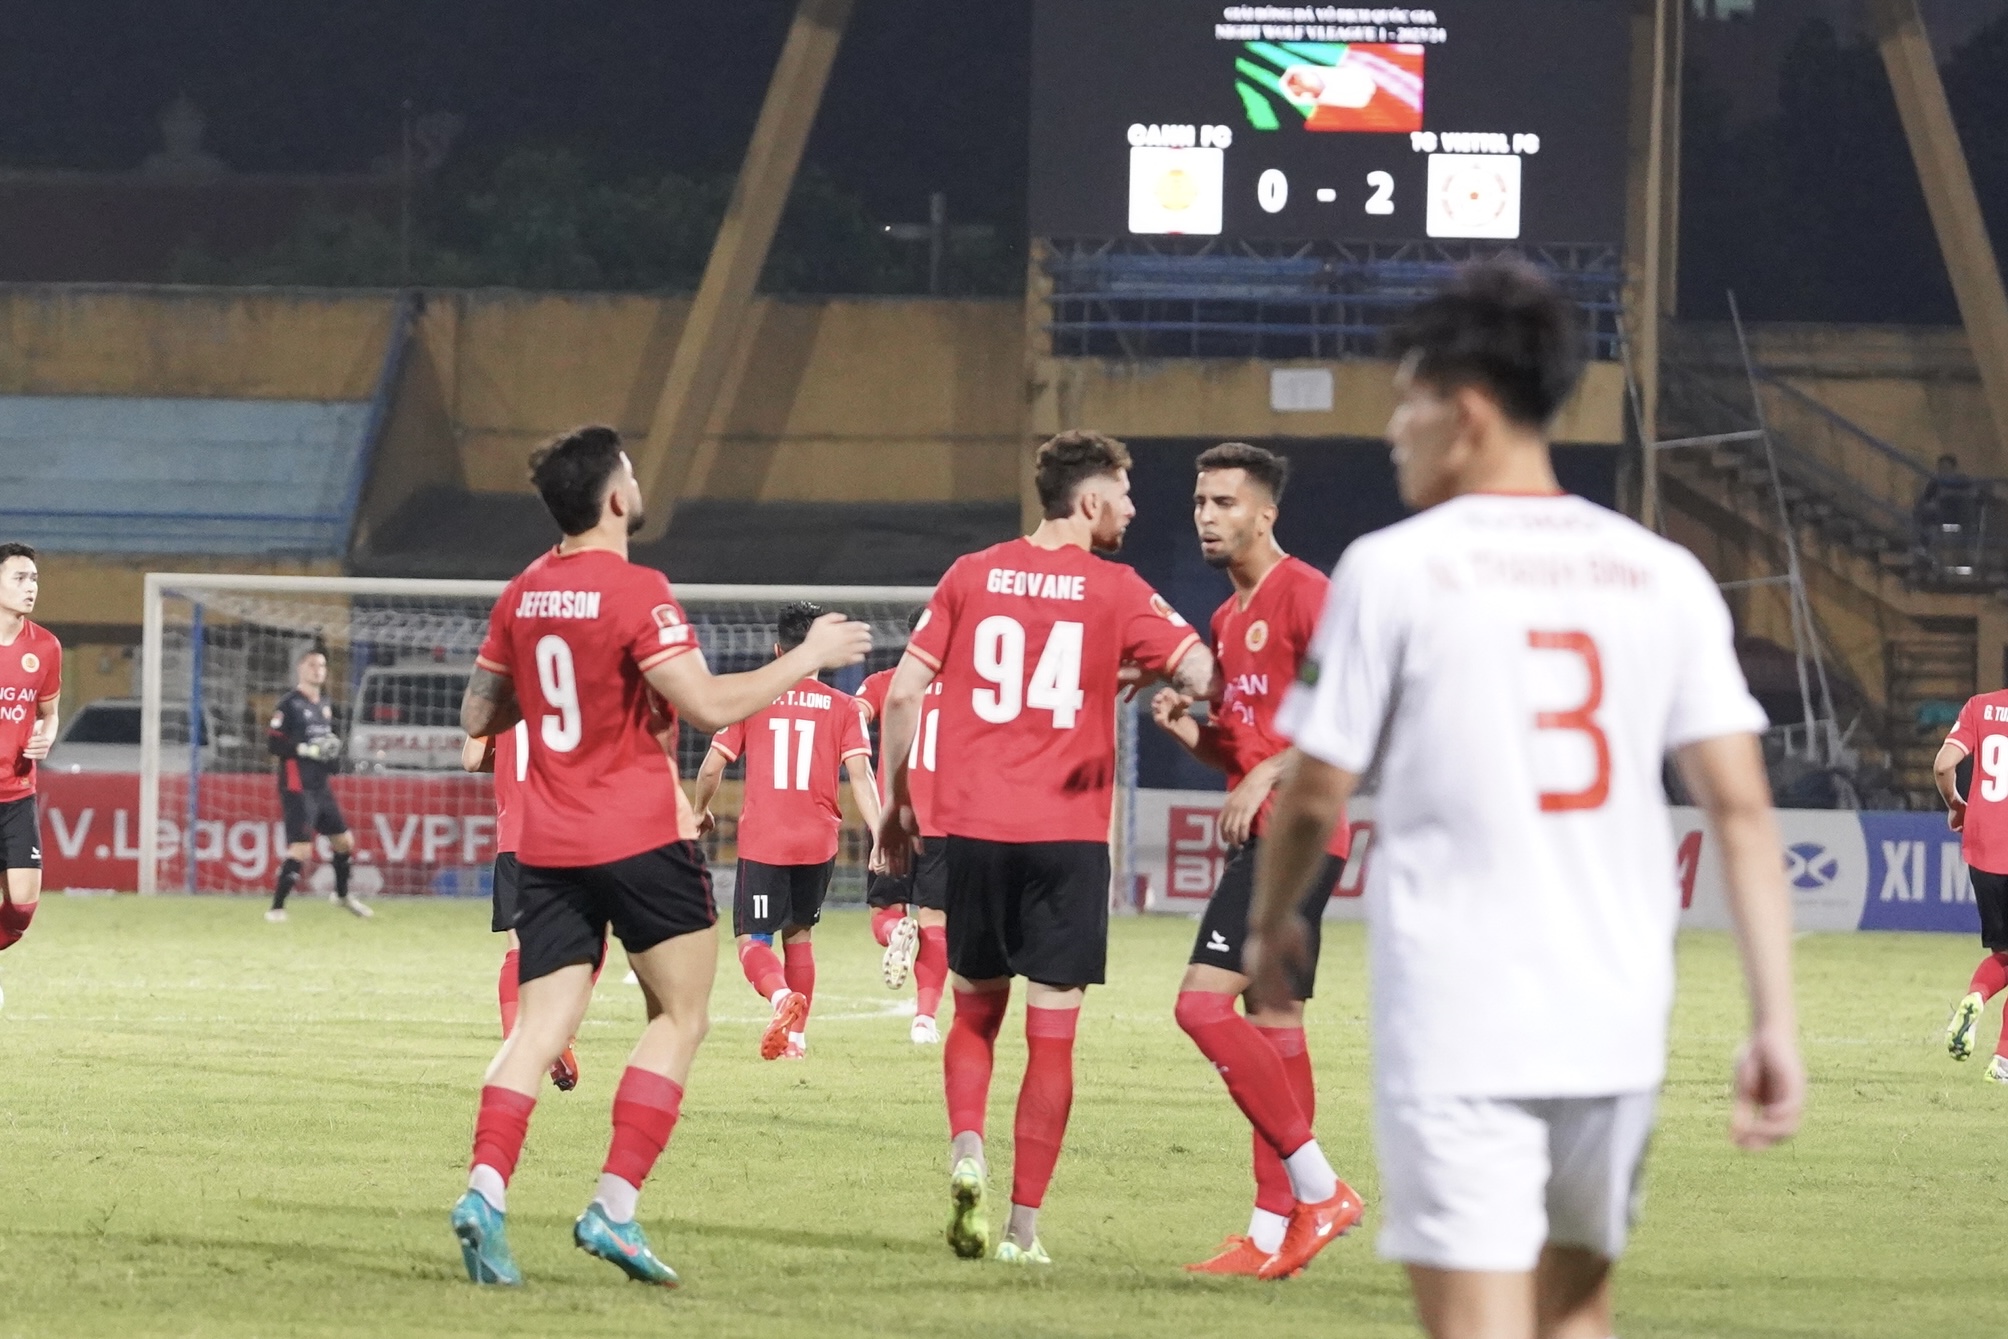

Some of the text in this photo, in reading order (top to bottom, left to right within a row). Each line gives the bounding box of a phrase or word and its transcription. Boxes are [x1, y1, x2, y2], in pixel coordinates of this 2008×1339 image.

[1257, 168, 1395, 215] 0 - 2
[515, 590, 601, 619] JEFERSON
[986, 568, 1086, 600] GEOVANE
[535, 634, 583, 752] 9
[971, 614, 1085, 729] 94
[1526, 629, 1612, 813] 3
[769, 718, 816, 791] 11
[1880, 840, 1926, 901] XI
[752, 894, 769, 919] 11
